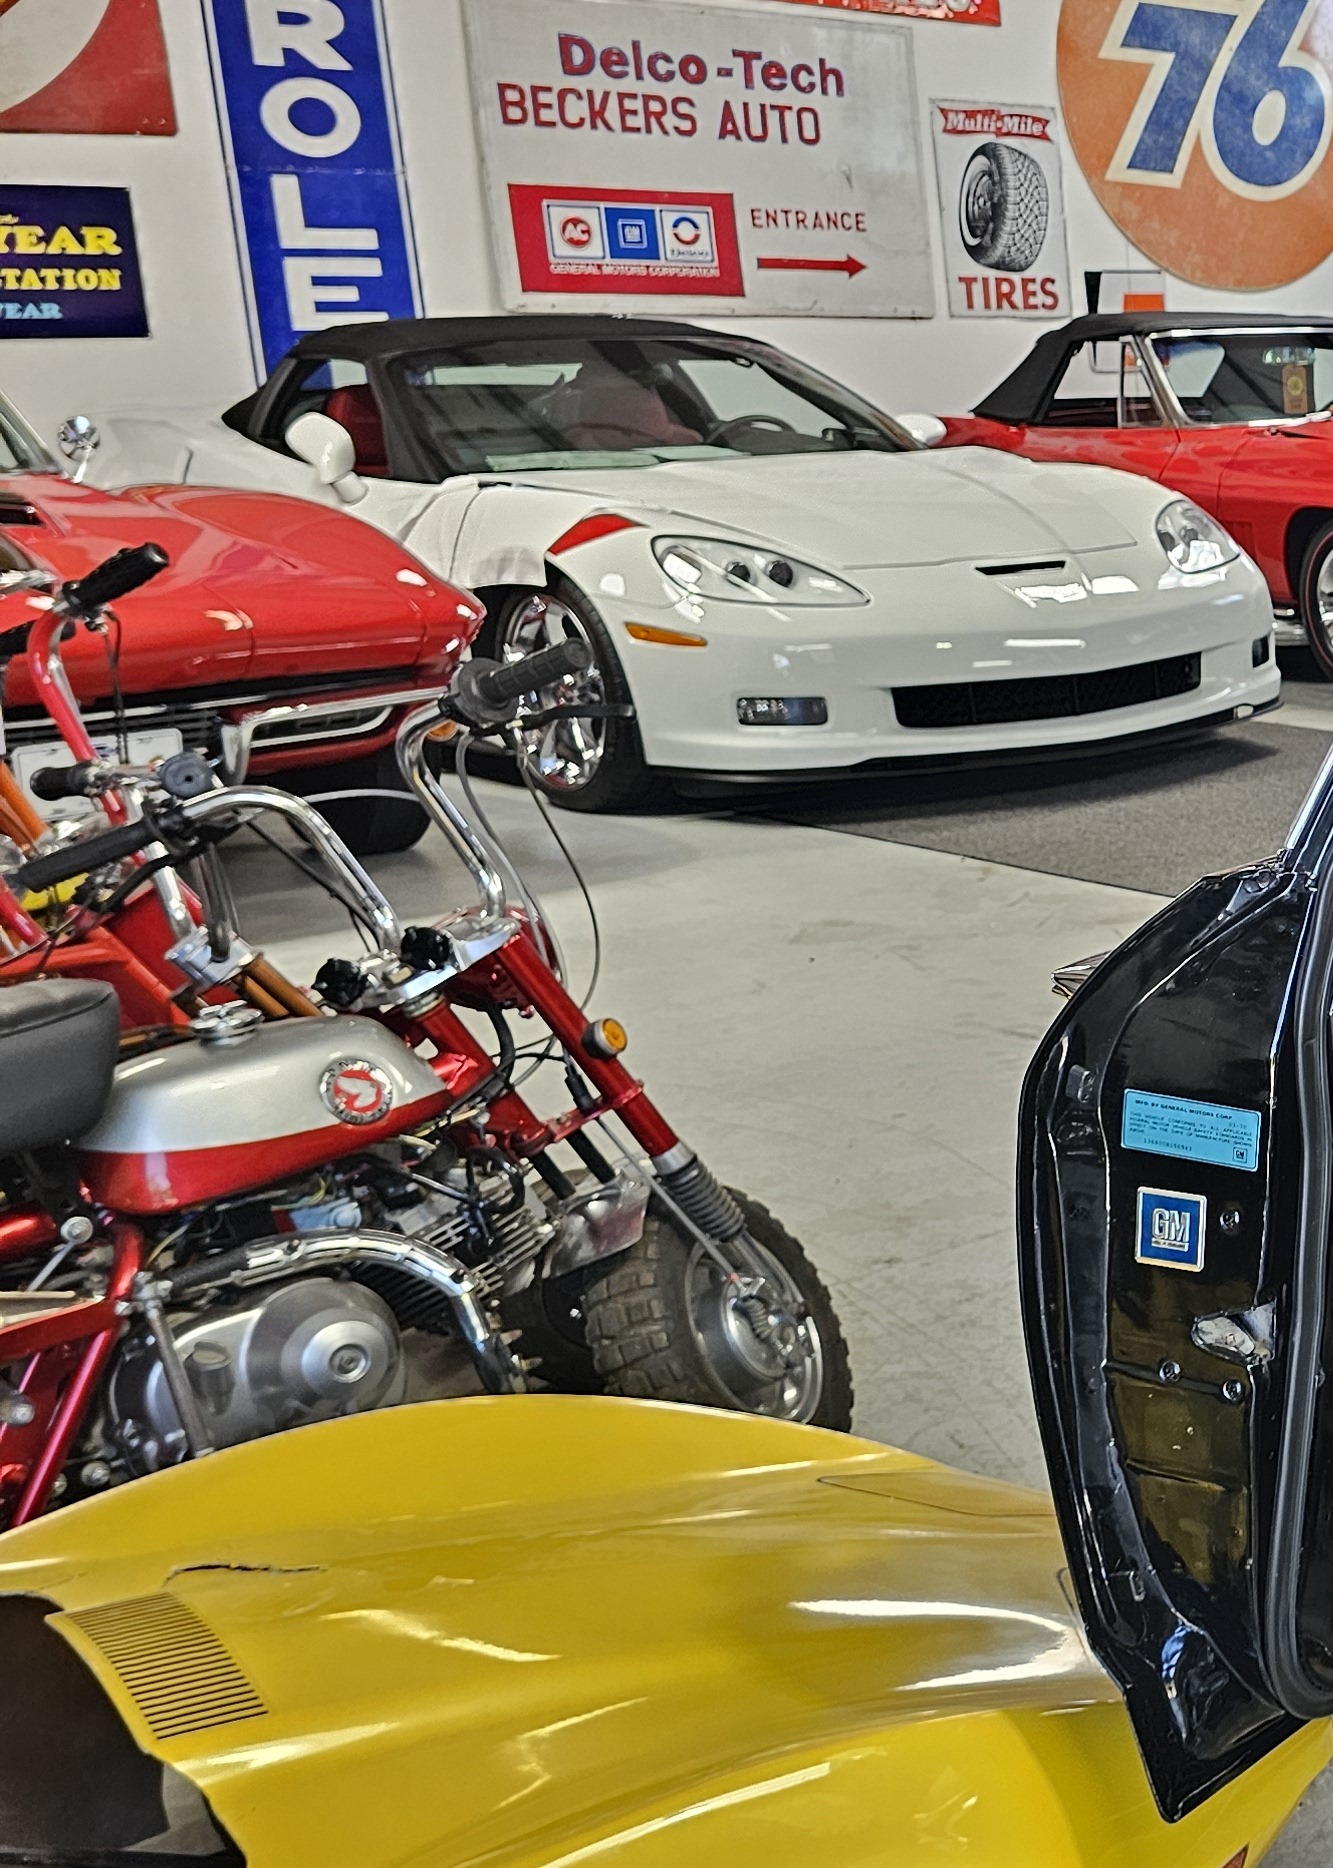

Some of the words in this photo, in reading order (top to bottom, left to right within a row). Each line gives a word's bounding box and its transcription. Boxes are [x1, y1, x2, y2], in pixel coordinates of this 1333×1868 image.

[1104, 0, 1333, 197] 76
[497, 82, 697, 138] BECKERS
[717, 99, 821, 146] AUTO
[946, 110, 1045, 136] Multi-Mile
[250, 0, 392, 331] ROLE
[751, 208, 868, 233] ENTRANCE
[0, 267, 122, 291] TATION
[550, 263, 600, 276] GENERAL
[602, 264, 647, 277] MOTORS
[650, 265, 721, 278] CORPORATION
[958, 276, 1060, 311] TIRES
[0, 302, 63, 320] EAR
[1161, 1104, 1187, 1113] GENERAL
[1189, 1109, 1214, 1117] MOTORS
[1236, 1150, 1244, 1159] GM
[1151, 1207, 1191, 1243] GM
